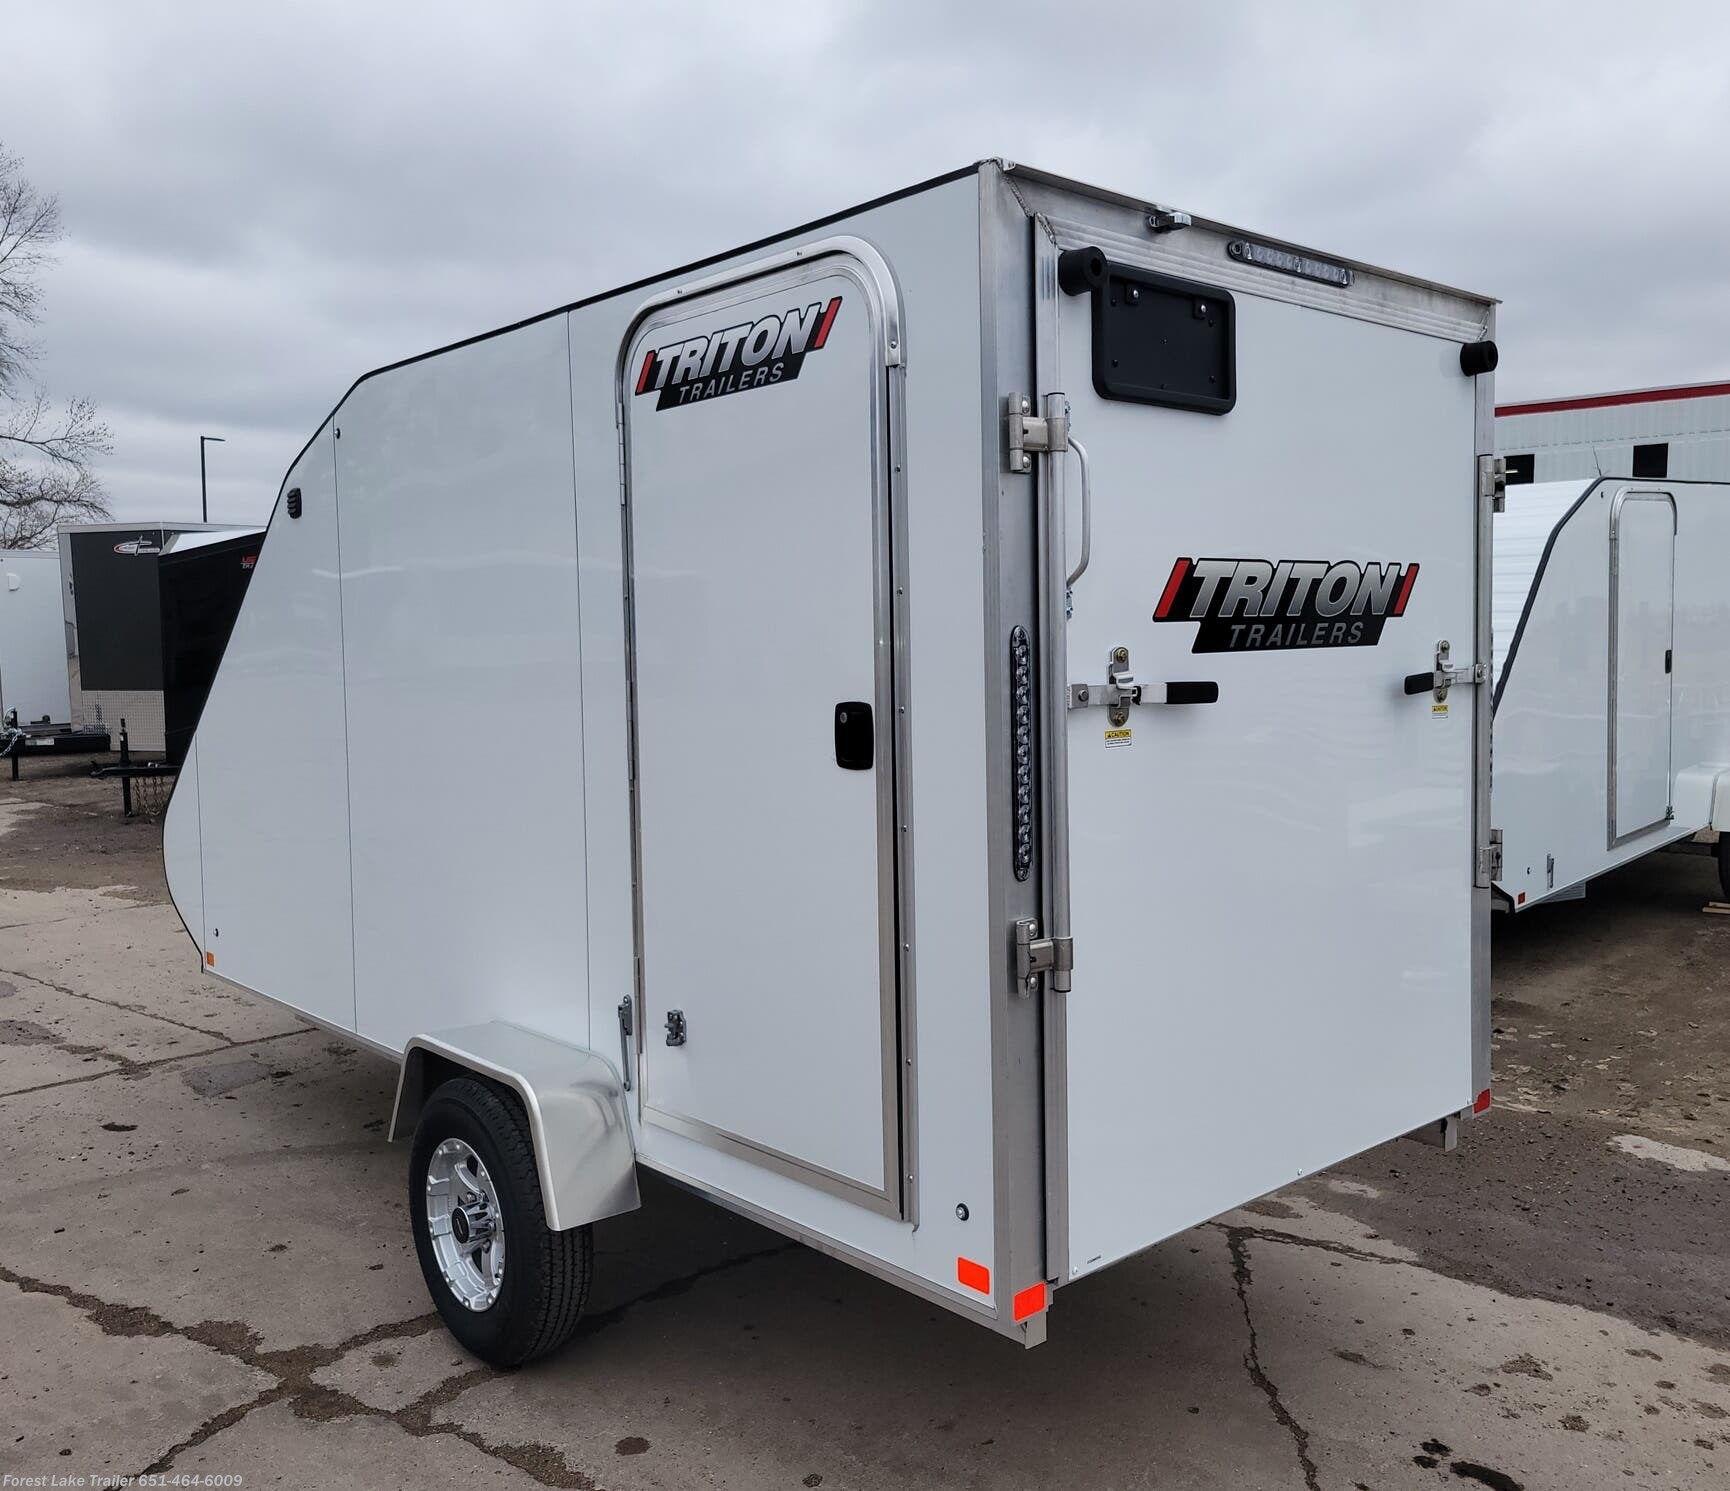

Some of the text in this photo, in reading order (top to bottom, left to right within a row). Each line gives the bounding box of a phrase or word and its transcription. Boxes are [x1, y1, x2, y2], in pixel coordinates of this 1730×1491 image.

[654, 302, 822, 390] TRITON
[679, 362, 785, 404] TRAILERS
[1189, 558, 1401, 618] TRITON
[1229, 621, 1364, 649] TRAILERS
